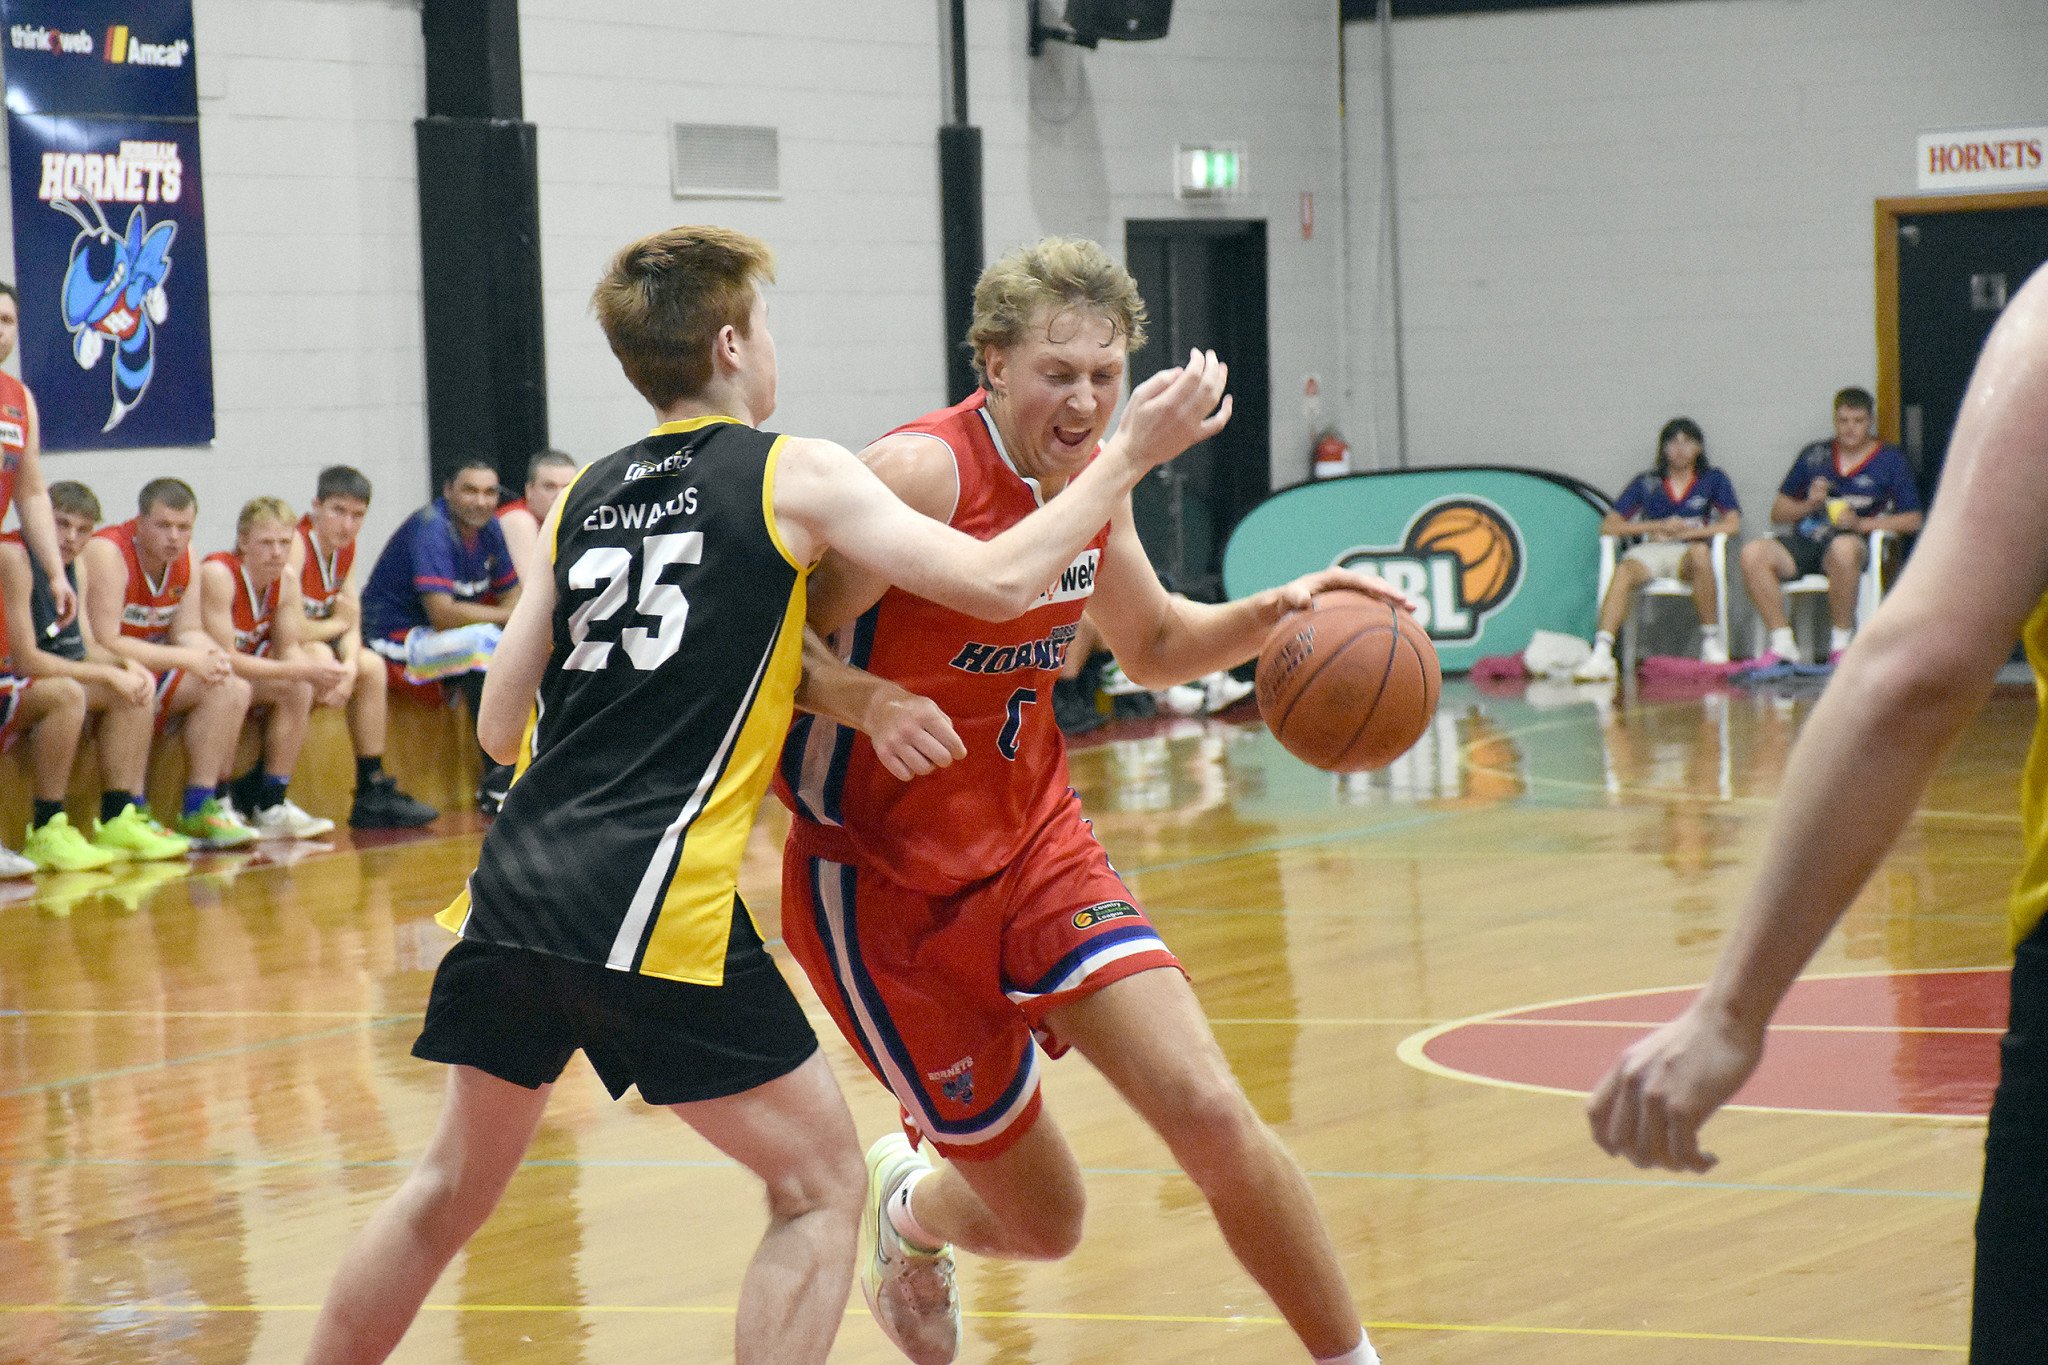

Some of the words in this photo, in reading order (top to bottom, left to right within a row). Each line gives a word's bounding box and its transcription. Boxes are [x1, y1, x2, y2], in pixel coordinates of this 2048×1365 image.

[39, 153, 182, 202] HORNETS
[1929, 140, 2041, 173] HORNETS
[562, 531, 704, 673] 25
[1347, 560, 1469, 631] BL
[949, 635, 1077, 674] HORNET
[928, 1055, 973, 1080] HORNETS
